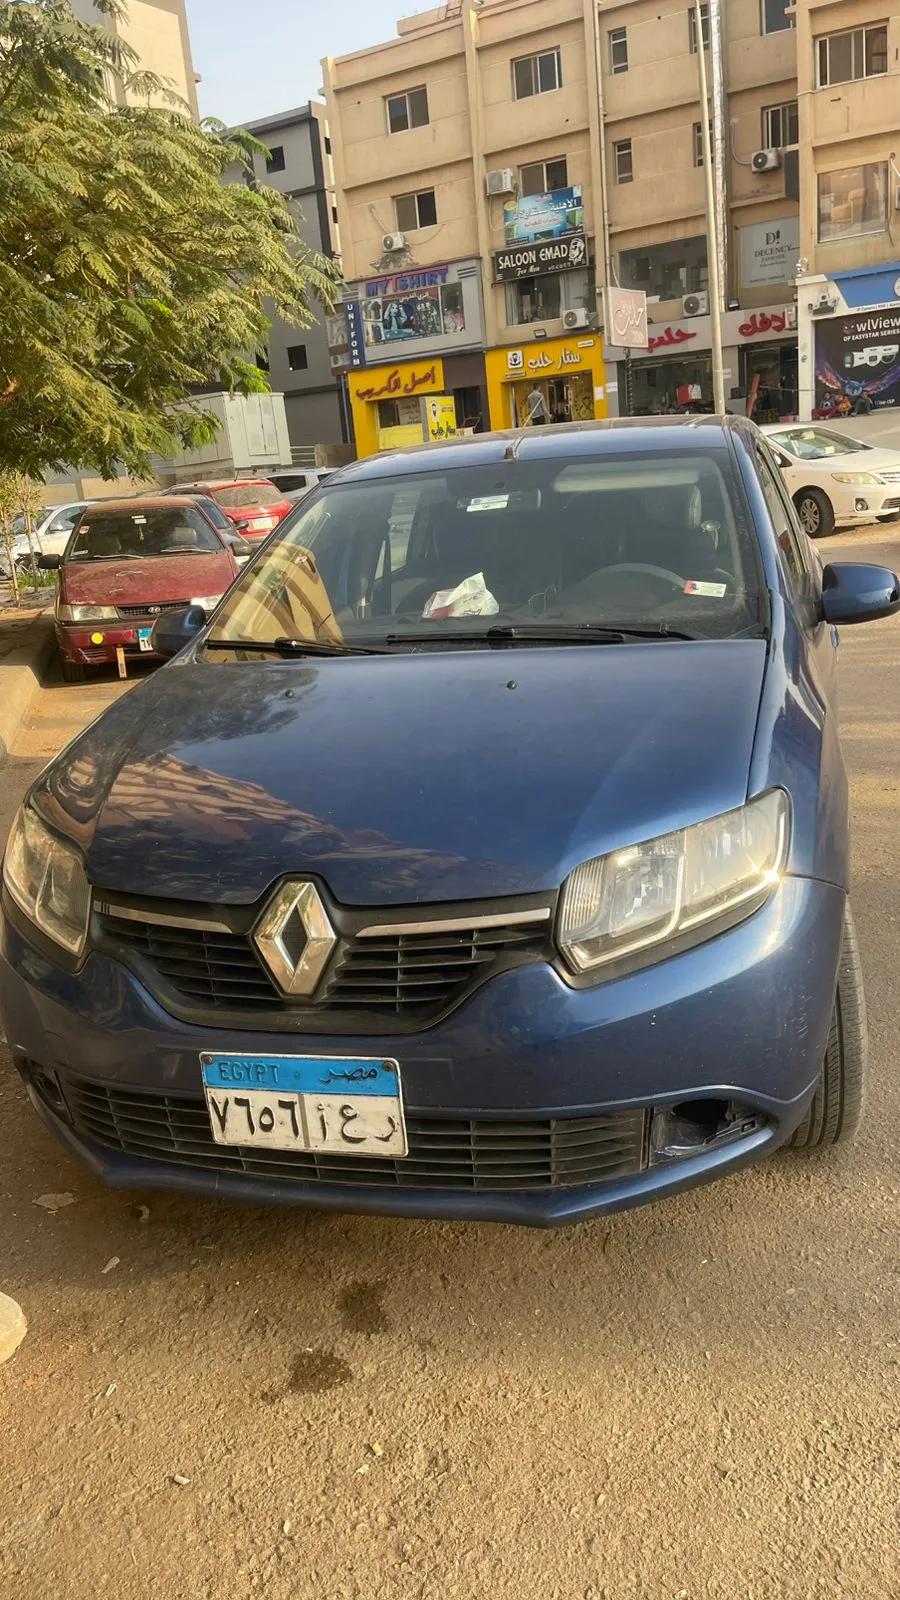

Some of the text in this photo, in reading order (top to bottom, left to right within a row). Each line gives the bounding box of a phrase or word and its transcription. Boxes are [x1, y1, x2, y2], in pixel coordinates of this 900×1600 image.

[498, 250, 536, 270] SALOON
[539, 244, 569, 261] EMAD
[754, 245, 793, 258] DECENCY
[515, 268, 527, 277] For
[365, 279, 390, 298] MY
[346, 304, 361, 366] UNIFORM
[852, 331, 880, 340] EASYSTAR
[527, 347, 581, 371] ستار حلب
[218, 1061, 281, 1083] EGYPT
[319, 1064, 379, 1085] مصر
[210, 1095, 301, 1140] ٧٦٥٦
